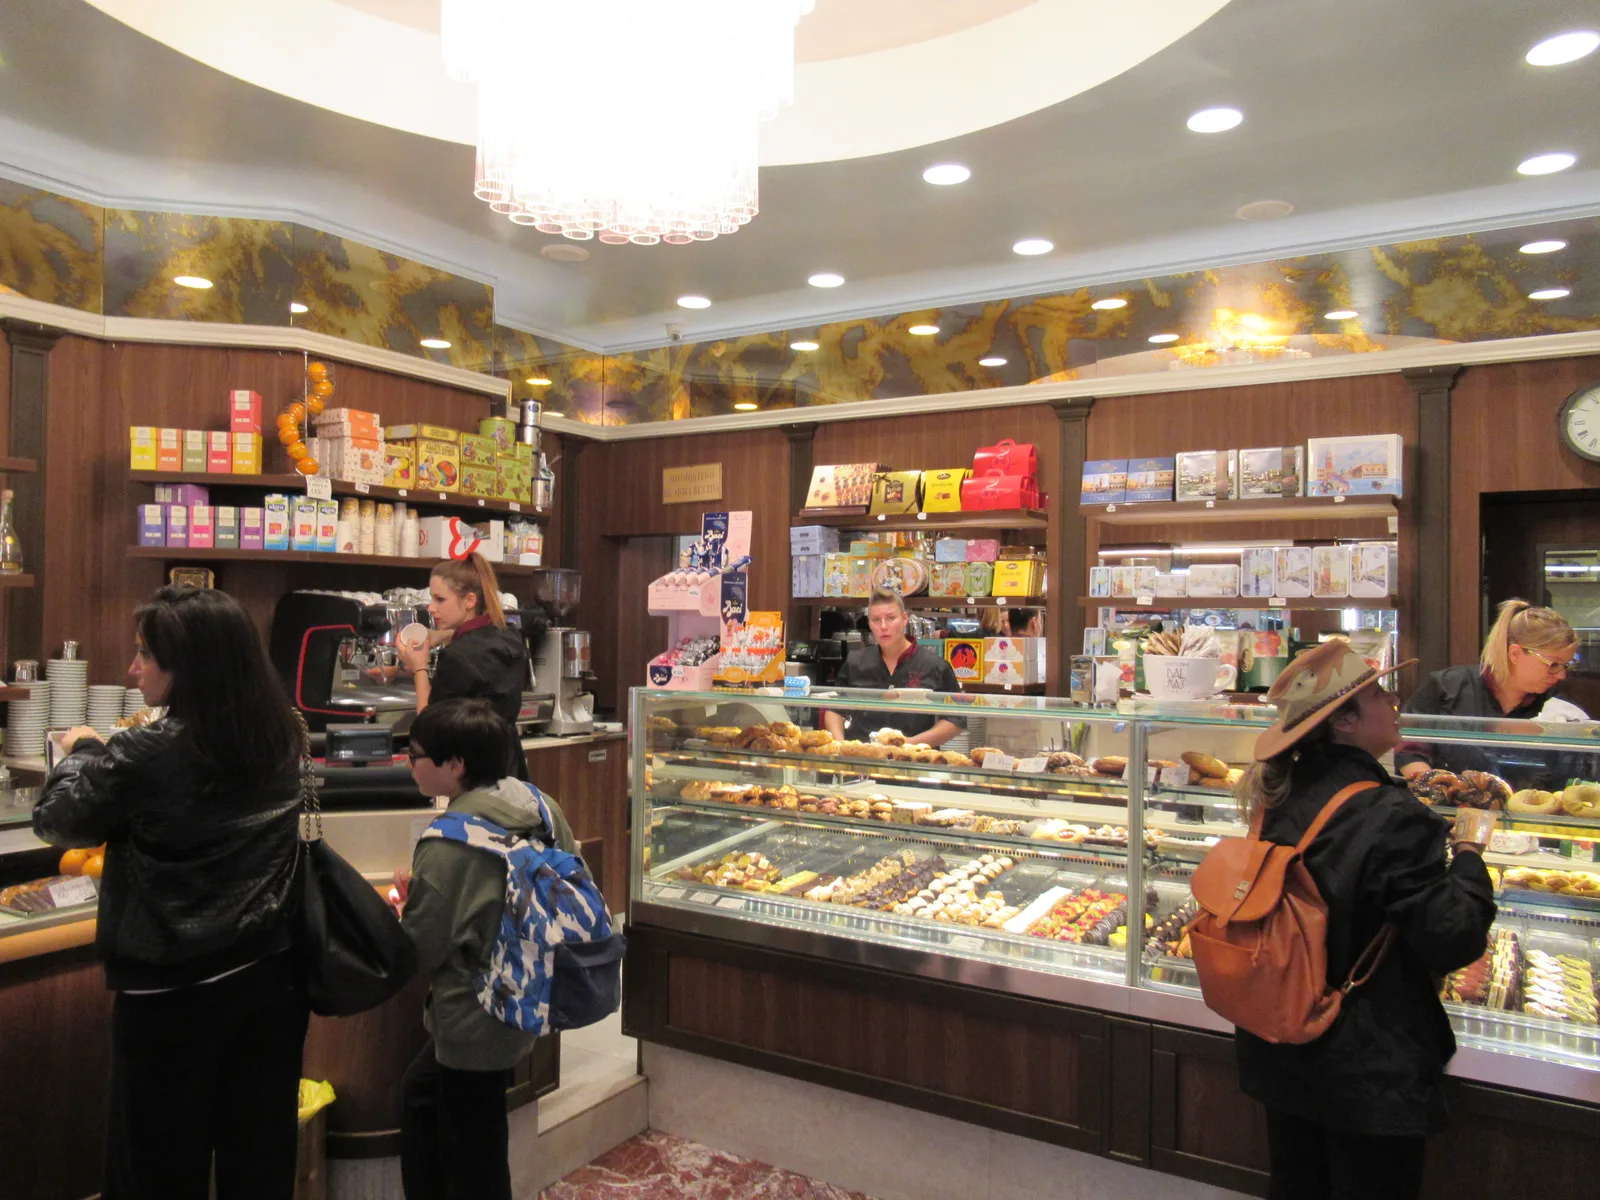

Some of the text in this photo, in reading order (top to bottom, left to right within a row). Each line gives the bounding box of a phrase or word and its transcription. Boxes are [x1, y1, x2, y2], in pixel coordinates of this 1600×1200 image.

[268, 504, 285, 512] alpro
[299, 505, 314, 513] alpro
[704, 530, 725, 542] Baci
[722, 600, 743, 618] Baci
